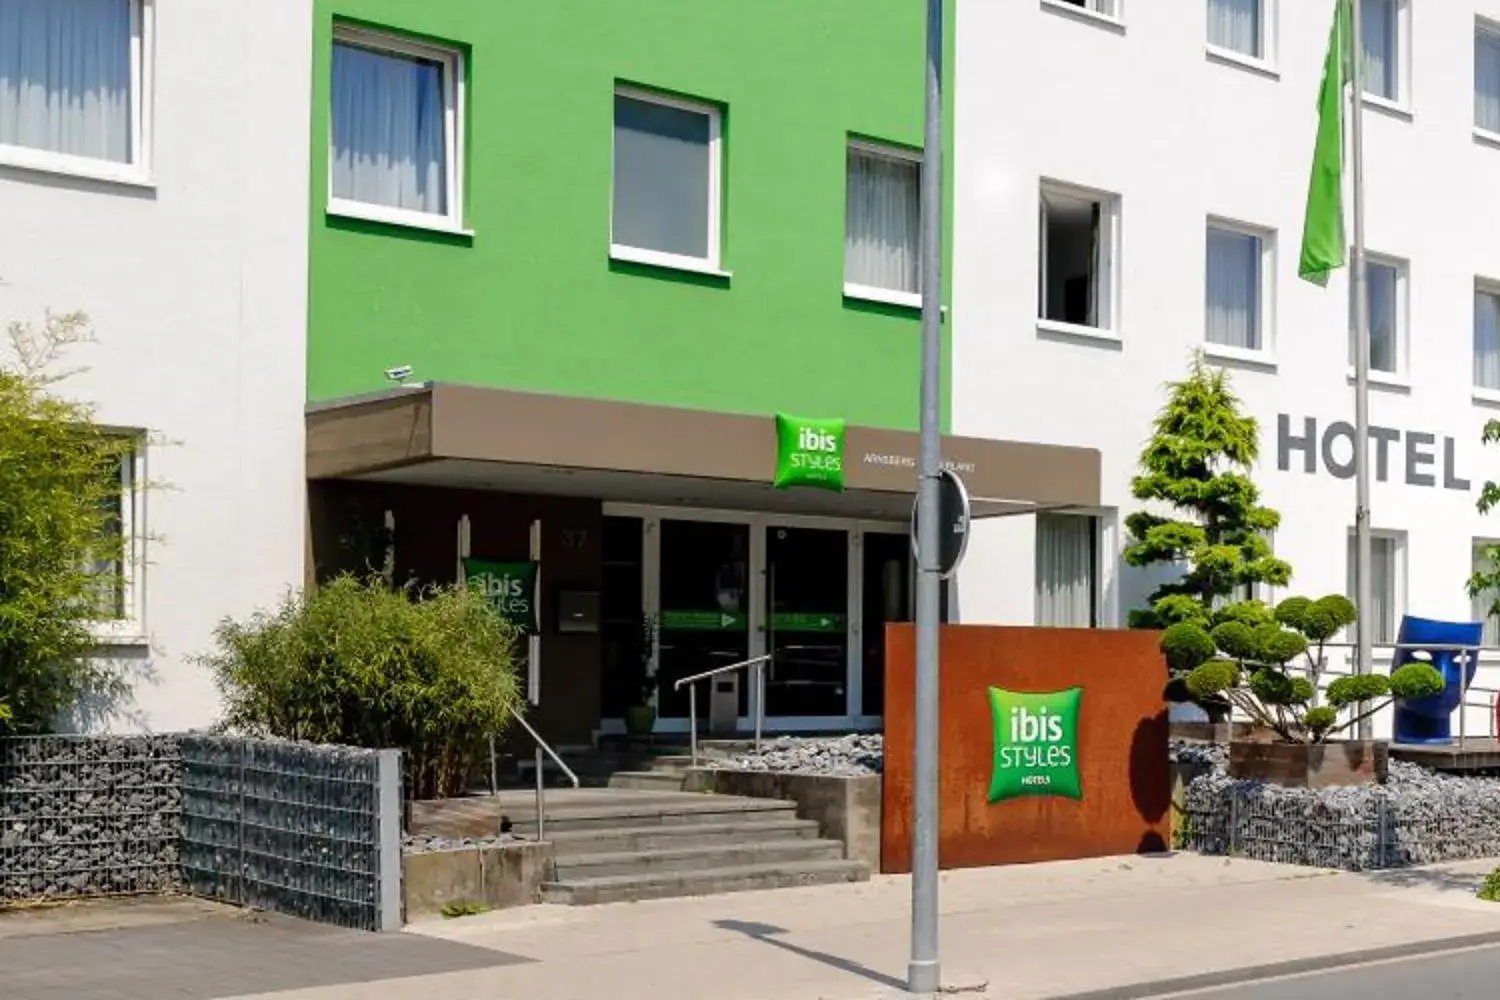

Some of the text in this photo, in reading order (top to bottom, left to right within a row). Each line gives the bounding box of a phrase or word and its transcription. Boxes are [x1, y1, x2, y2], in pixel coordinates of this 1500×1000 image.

[799, 426, 837, 452] ibis
[1278, 413, 1471, 490] HOTEL
[559, 528, 588, 550] 37
[479, 572, 524, 597] ibis
[1010, 705, 1063, 742] ibis
